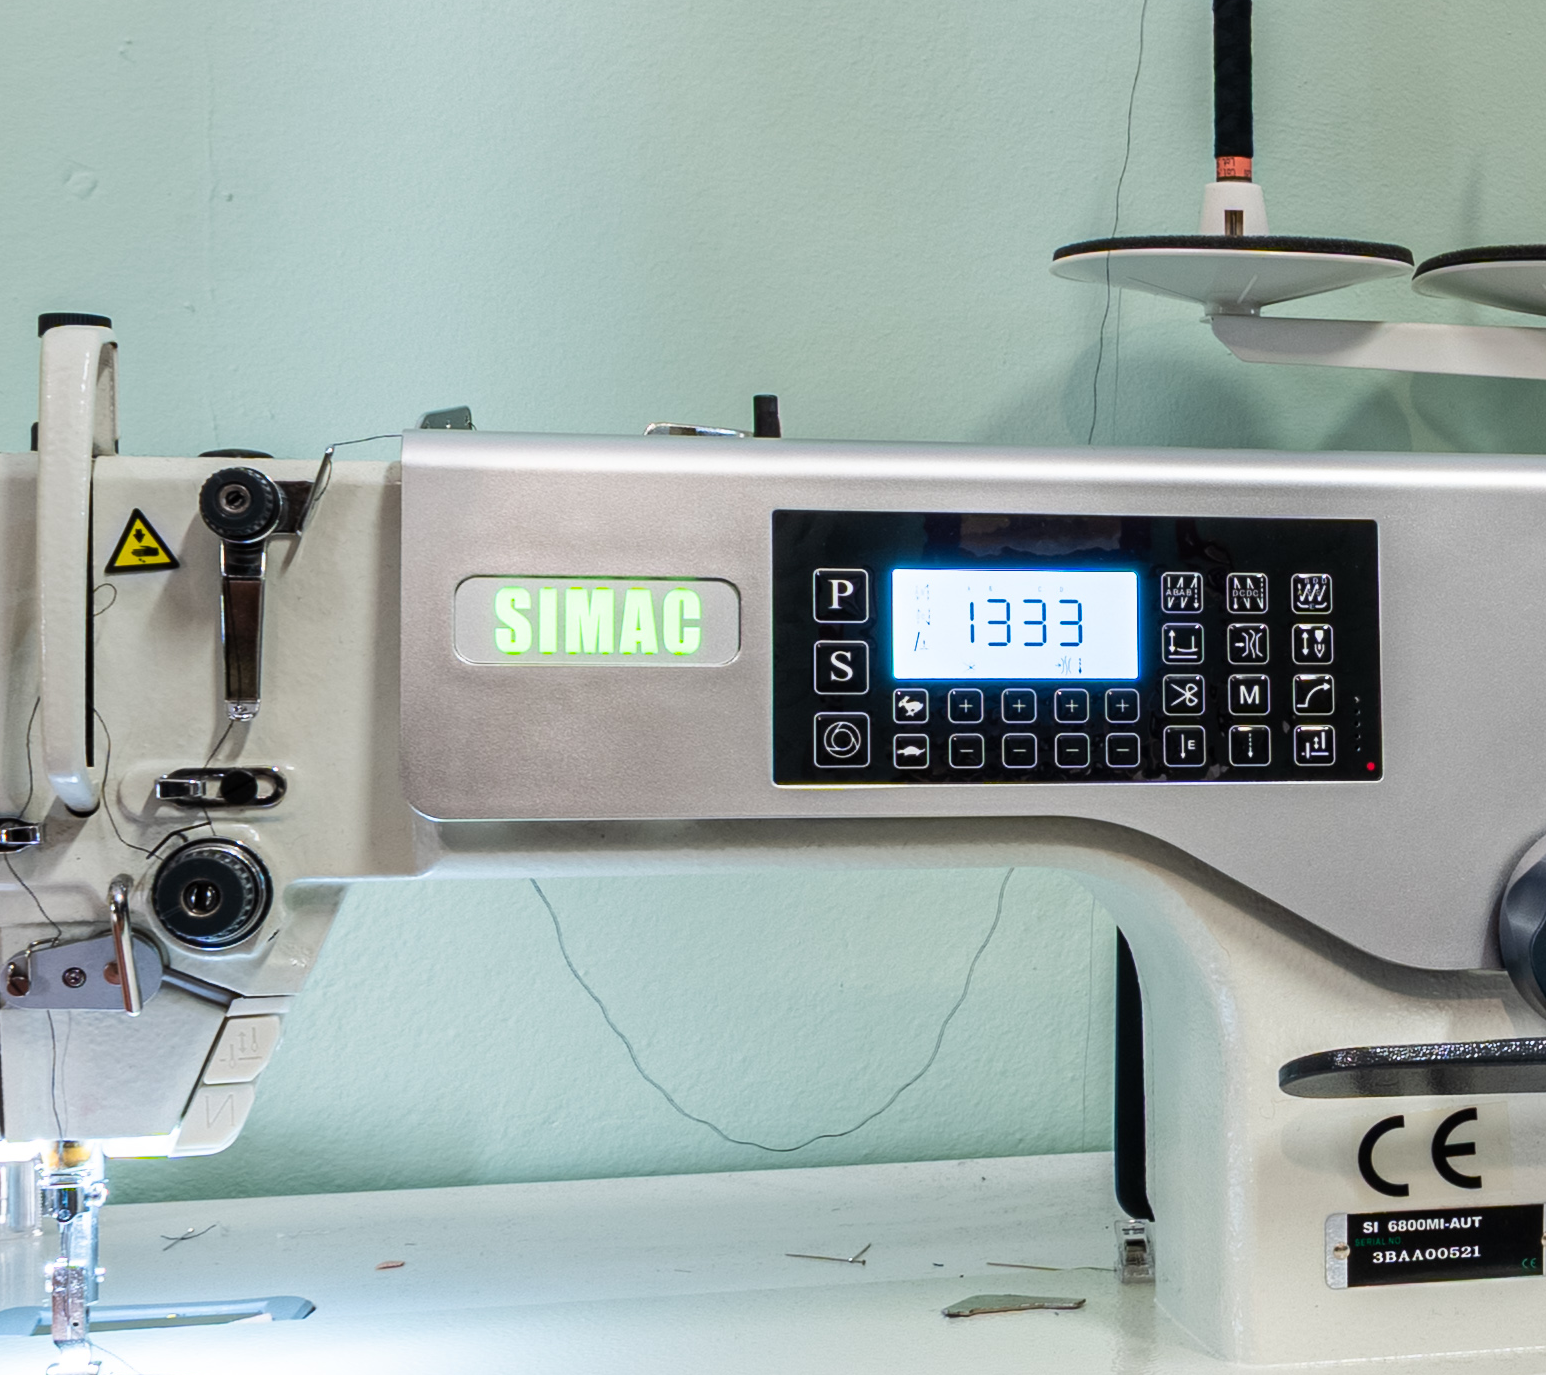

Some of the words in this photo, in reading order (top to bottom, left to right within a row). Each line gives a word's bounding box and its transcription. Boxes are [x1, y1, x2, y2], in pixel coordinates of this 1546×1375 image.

[828, 579, 853, 609] P
[494, 586, 701, 655] SIMAC
[969, 599, 1083, 647] 1333
[830, 651, 853, 681] S
[1239, 685, 1259, 705] M
[1188, 740, 1196, 750] E
[1357, 1107, 1482, 1197] CE
[1363, 1221, 1379, 1234] SI
[1388, 1216, 1483, 1232] 6800MI-AUT
[1354, 1237, 1385, 1247] SERIAL
[1372, 1245, 1481, 1264] 3BAA00521
